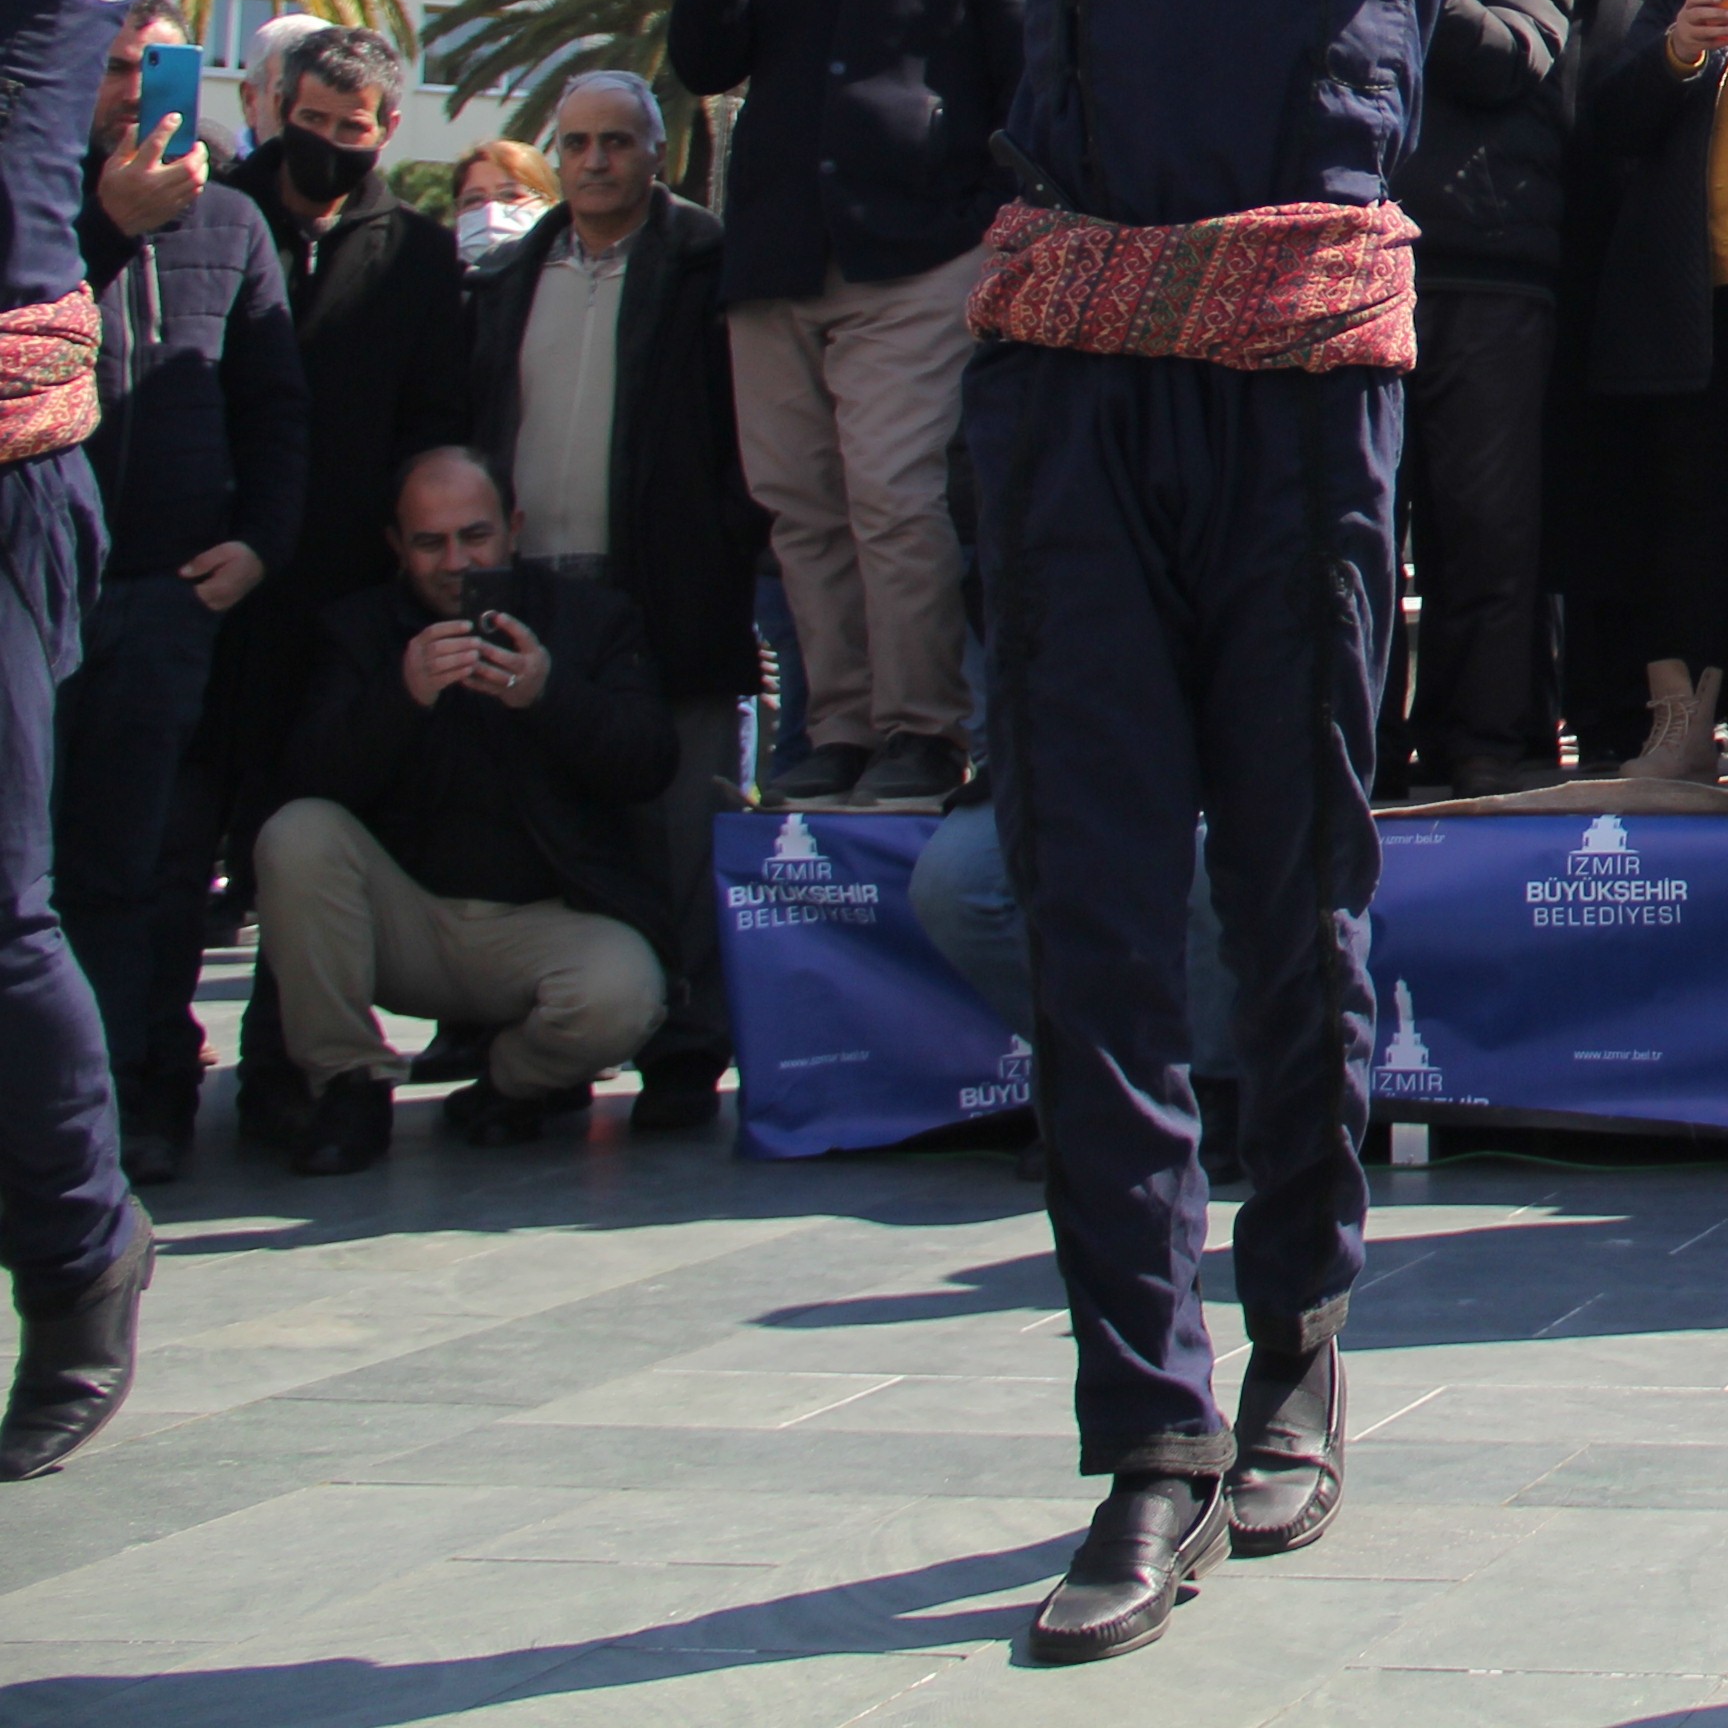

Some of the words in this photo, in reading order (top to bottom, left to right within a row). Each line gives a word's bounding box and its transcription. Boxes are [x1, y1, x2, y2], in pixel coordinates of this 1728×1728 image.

[763, 860, 832, 881] İZMİR
[1566, 855, 1641, 875] İZMİR
[1526, 876, 1688, 904] BÜYÜKŞEHİR
[737, 905, 877, 931] BELEDİYESİ
[1533, 904, 1682, 927] BELEDİYESİ
[1372, 1071, 1443, 1091] İZMİR
